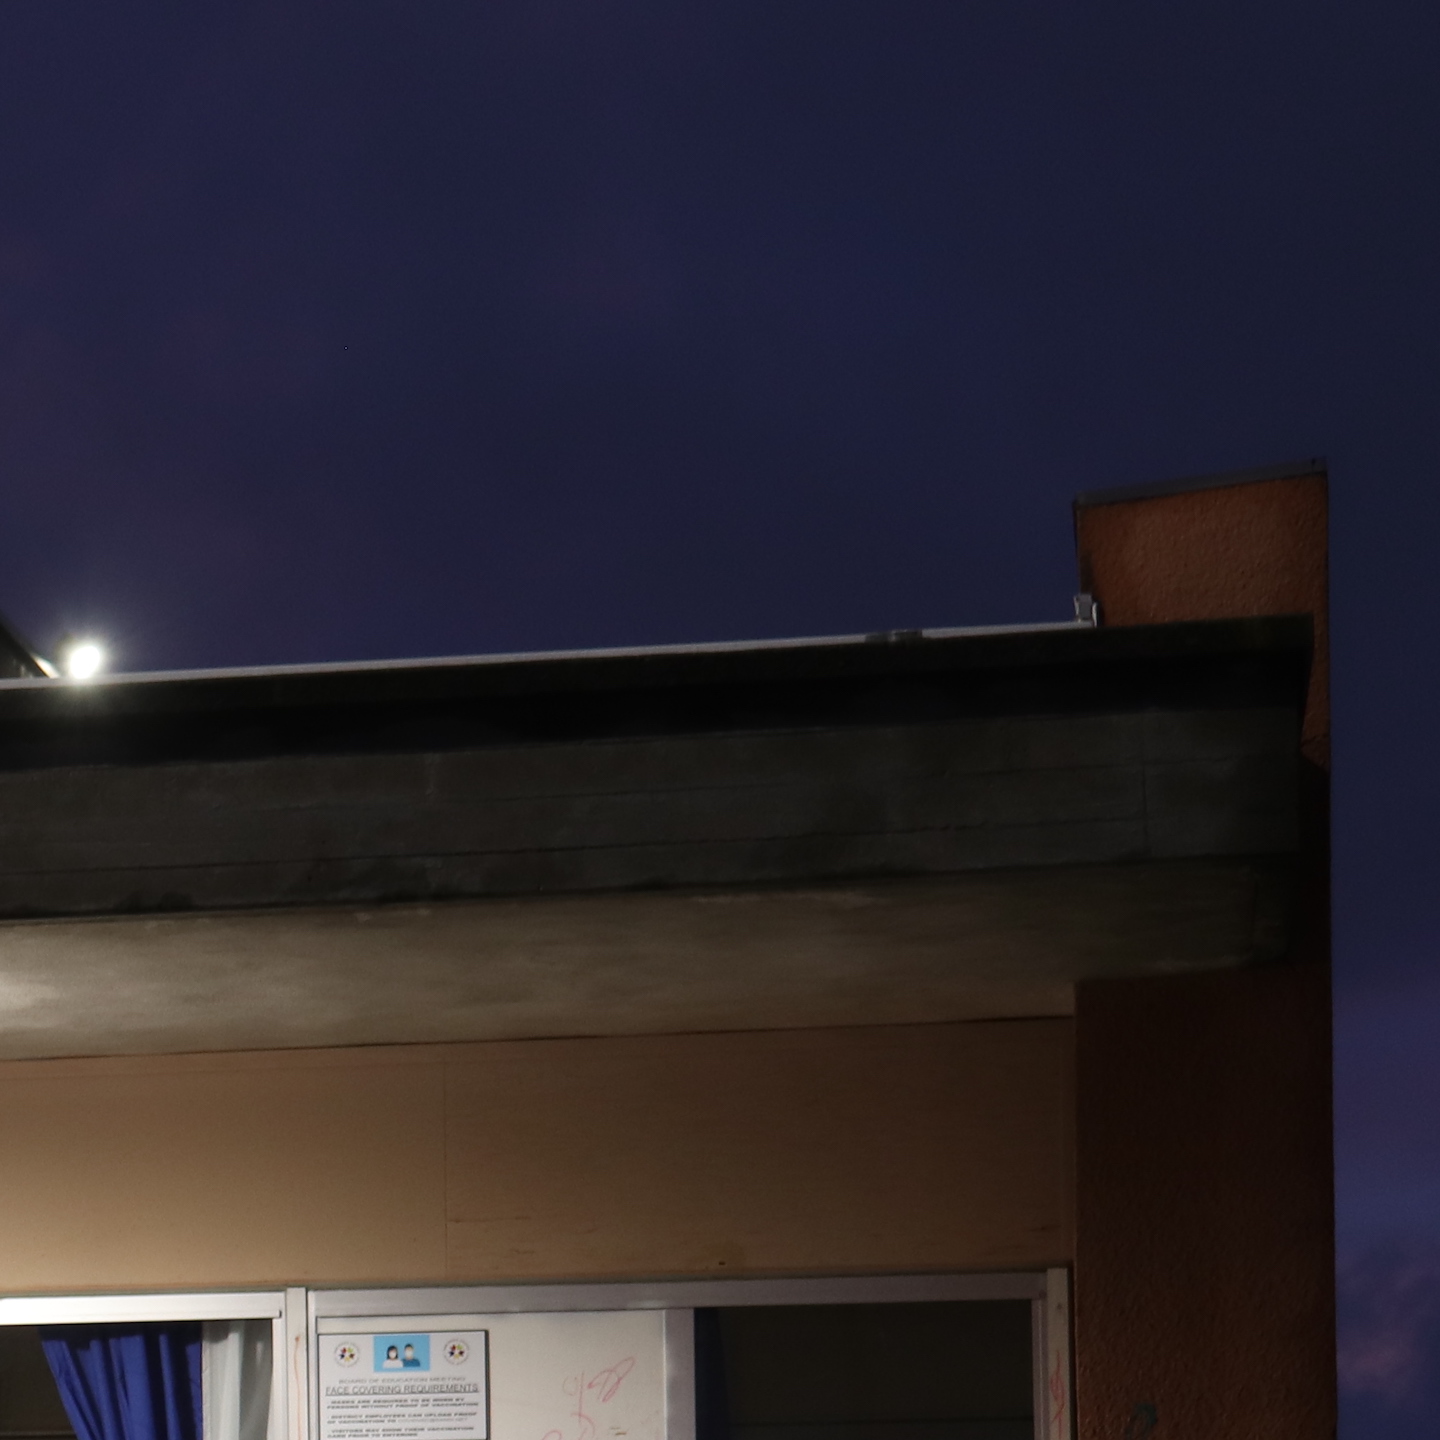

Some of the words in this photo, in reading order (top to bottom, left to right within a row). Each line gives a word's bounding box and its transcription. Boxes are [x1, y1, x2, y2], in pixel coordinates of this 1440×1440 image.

[326, 1386, 350, 1396] FACE
[352, 1385, 401, 1395] COVERING
[404, 1384, 479, 1394] REQUIREMENTS
